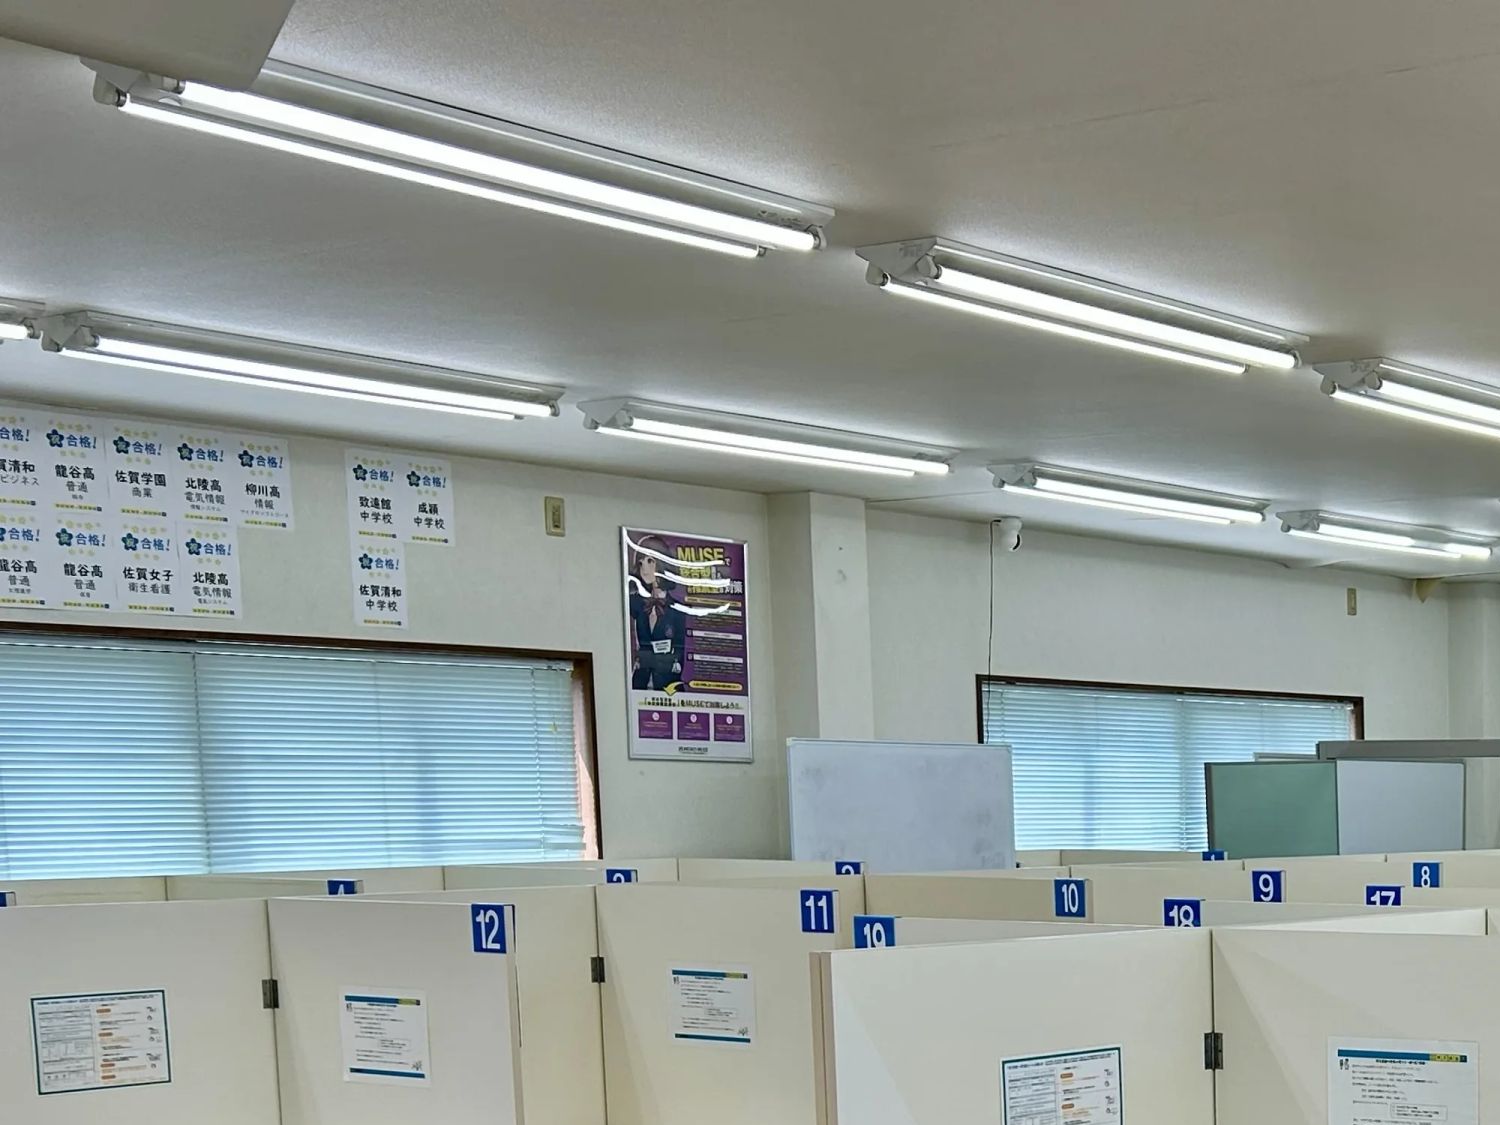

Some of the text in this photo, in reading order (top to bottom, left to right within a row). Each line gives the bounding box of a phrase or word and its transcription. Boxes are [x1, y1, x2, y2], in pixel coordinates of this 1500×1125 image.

[66, 434, 97, 449] 合格!
[132, 441, 162, 456] 合格!
[195, 448, 224, 462] 合格!
[256, 455, 283, 469] 合格!
[115, 470, 166, 486] 佐賀学園
[369, 469, 394, 482] 合格!
[422, 475, 446, 488] 合格!
[254, 498, 274, 510] 情報
[360, 511, 393, 524] 中学校
[413, 516, 446, 530] 中学校
[8, 527, 40, 542] 合格!
[75, 532, 106, 547] 合格!
[140, 538, 170, 551] 合格!
[203, 542, 231, 556] 合格!
[374, 558, 400, 571] 合格!
[123, 566, 174, 581] 佐賀女子
[359, 584, 402, 598] 佐賀清和
[365, 599, 399, 612] 中学校
[1421, 866, 1430, 888] 8
[1259, 874, 1274, 901] 9
[1062, 883, 1078, 913] 10
[805, 895, 828, 930] 11
[476, 910, 500, 949] 12
